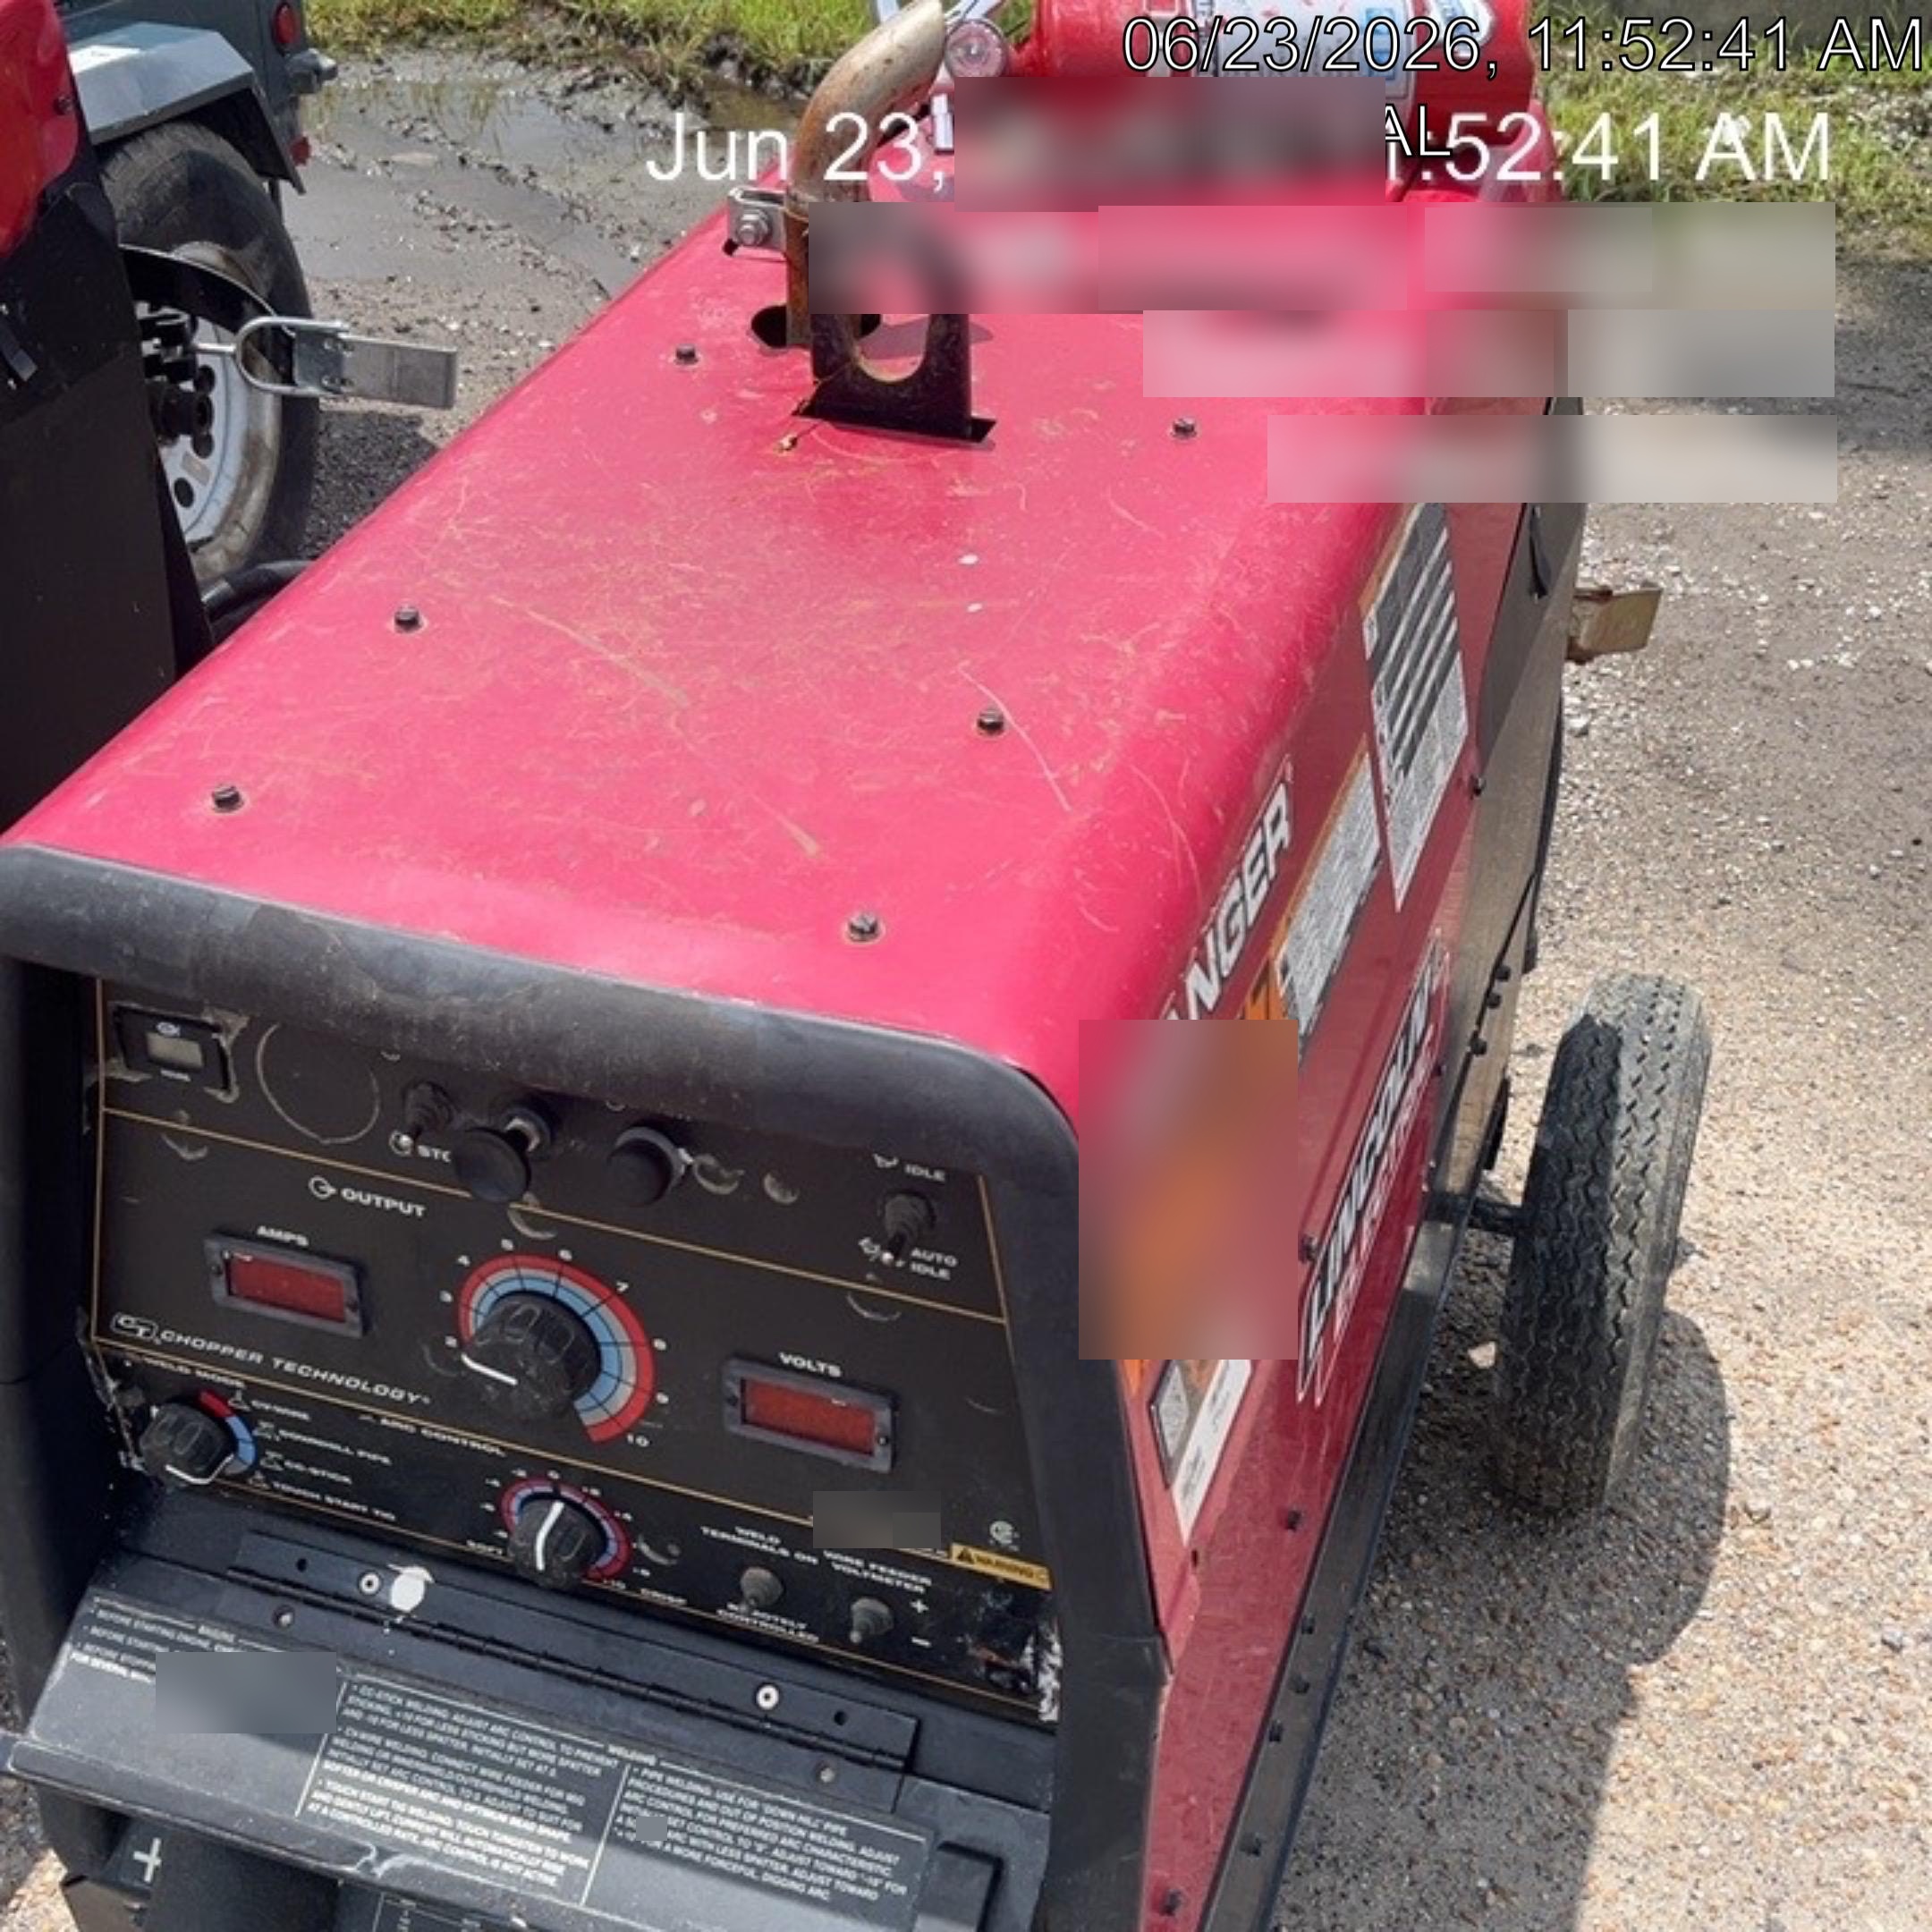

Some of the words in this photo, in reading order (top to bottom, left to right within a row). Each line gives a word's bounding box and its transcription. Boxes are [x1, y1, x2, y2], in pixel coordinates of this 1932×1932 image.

[1166, 781, 1290, 1020] NGER
[418, 1144, 452, 1162] STO
[905, 1164, 945, 1182] IDLE
[341, 1188, 426, 1217] OUTPUT
[257, 1225, 309, 1247] AMPS
[911, 1248, 958, 1267] AUTO
[910, 1262, 951, 1280] IDLE
[160, 1329, 264, 1364] CHOPPER
[779, 1352, 841, 1377] VOLTS
[420, 1428, 506, 1458] CONTROL
[627, 1433, 649, 1447] 10
[700, 1526, 790, 1557] TERMINALS
[793, 1551, 819, 1565] ON
[832, 1563, 926, 1594] VOLTMETER
[869, 1563, 932, 1587] FEEDER
